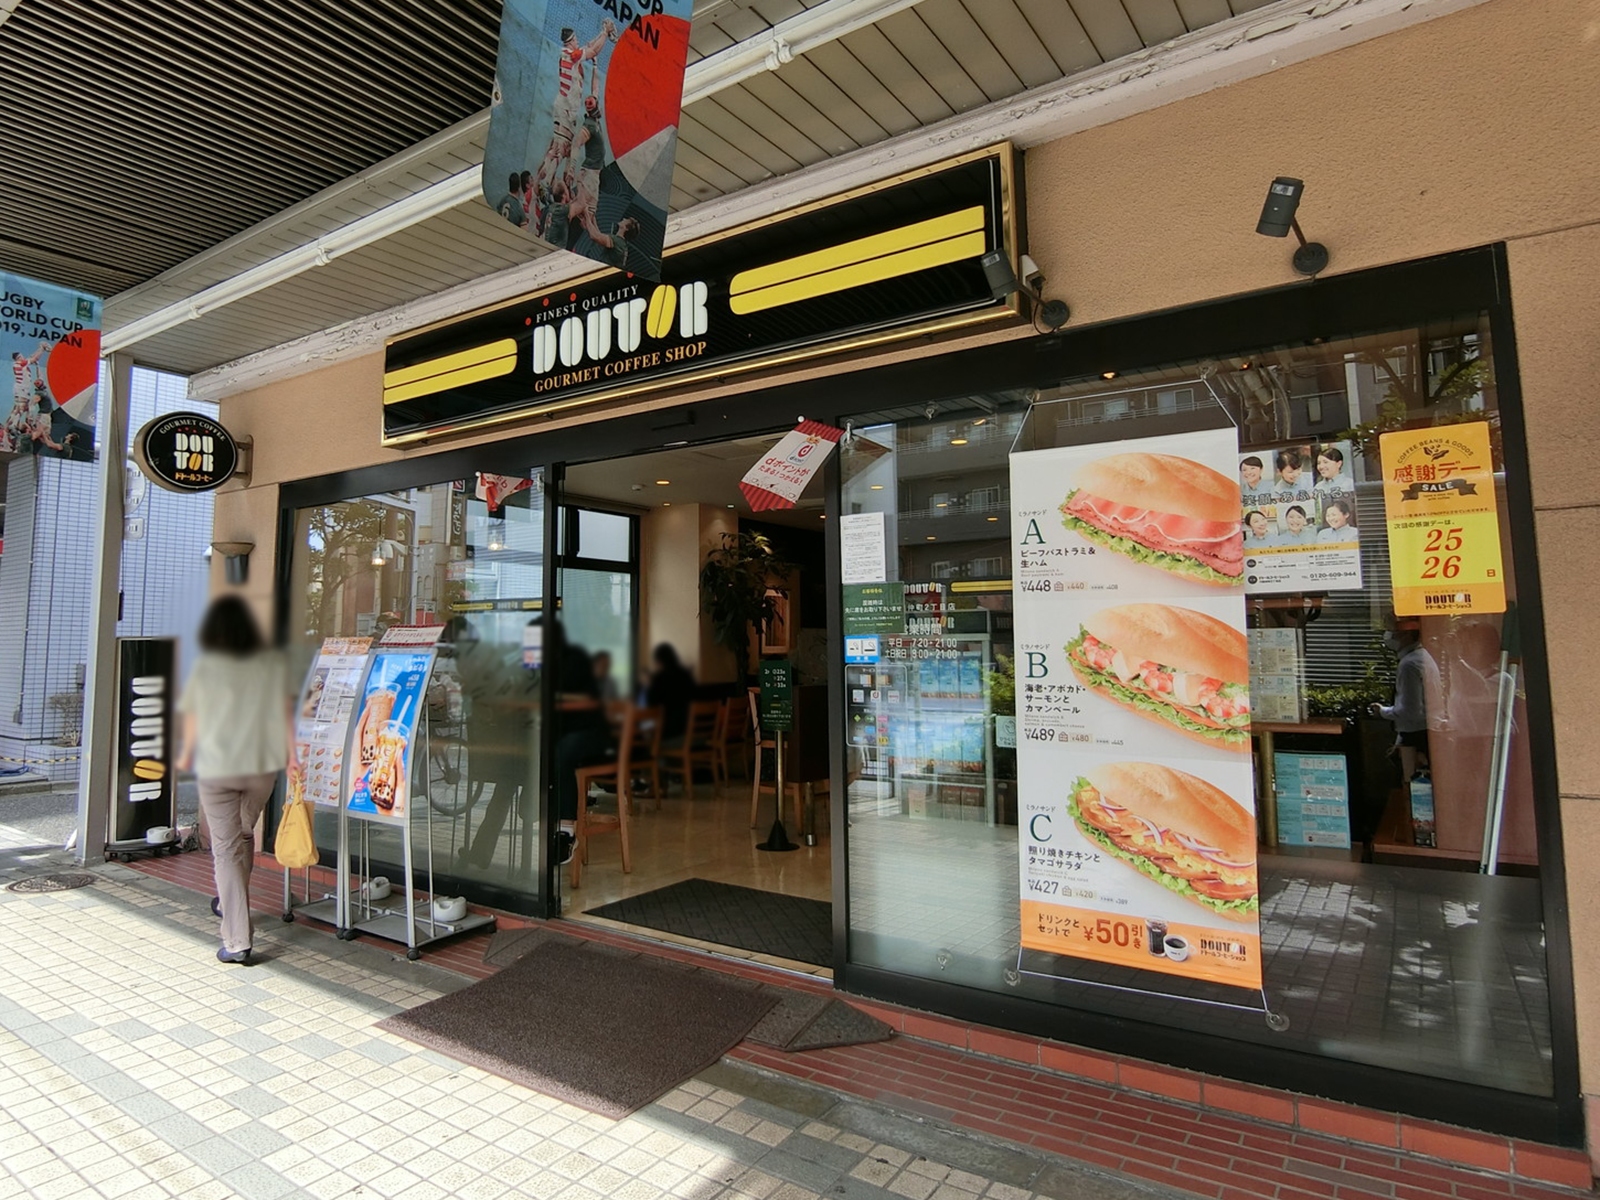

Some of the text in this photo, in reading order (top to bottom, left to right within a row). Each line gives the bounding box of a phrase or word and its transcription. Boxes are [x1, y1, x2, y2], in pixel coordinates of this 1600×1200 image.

[594, 0, 660, 50] APAN
[536, 284, 639, 324] FINEST QUALITY
[0, 305, 83, 332] ORLD CUP
[533, 281, 709, 374] DOUTOR
[0, 321, 82, 348] 19, JAPAN
[534, 342, 707, 393] GOURMET COFFEE SHOP
[159, 419, 226, 442] GOURMET COFFEE
[1398, 444, 1418, 464] COFFEE
[1452, 440, 1474, 456] GOODS
[175, 472, 213, 482] ドトールコーヒー
[1393, 461, 1481, 484] 感謝デー
[1422, 482, 1454, 492] SALE
[1020, 518, 1046, 545] A
[1424, 528, 1464, 552] 25
[1020, 559, 1048, 568] 生ハム
[1421, 556, 1462, 579] 26
[1486, 568, 1496, 578] 日
[1022, 580, 1051, 592] ¥448
[1425, 592, 1471, 604] DOUTOR
[1024, 652, 1048, 678] B
[1025, 695, 1070, 704] サーモンと
[1025, 705, 1080, 714] カマンベール
[129, 676, 166, 802] DOUTOR
[1026, 728, 1055, 742] ¥489
[1030, 814, 1052, 842] C
[1028, 846, 1100, 863] 照り焼きチキンと
[1029, 857, 1083, 871] タマゴサラダ
[1028, 880, 1059, 894] ¥427
[1037, 924, 1070, 938] セットで
[1038, 913, 1080, 929] ドリンクと
[1083, 918, 1130, 947] ¥50
[1200, 938, 1246, 956] DOUTOR
